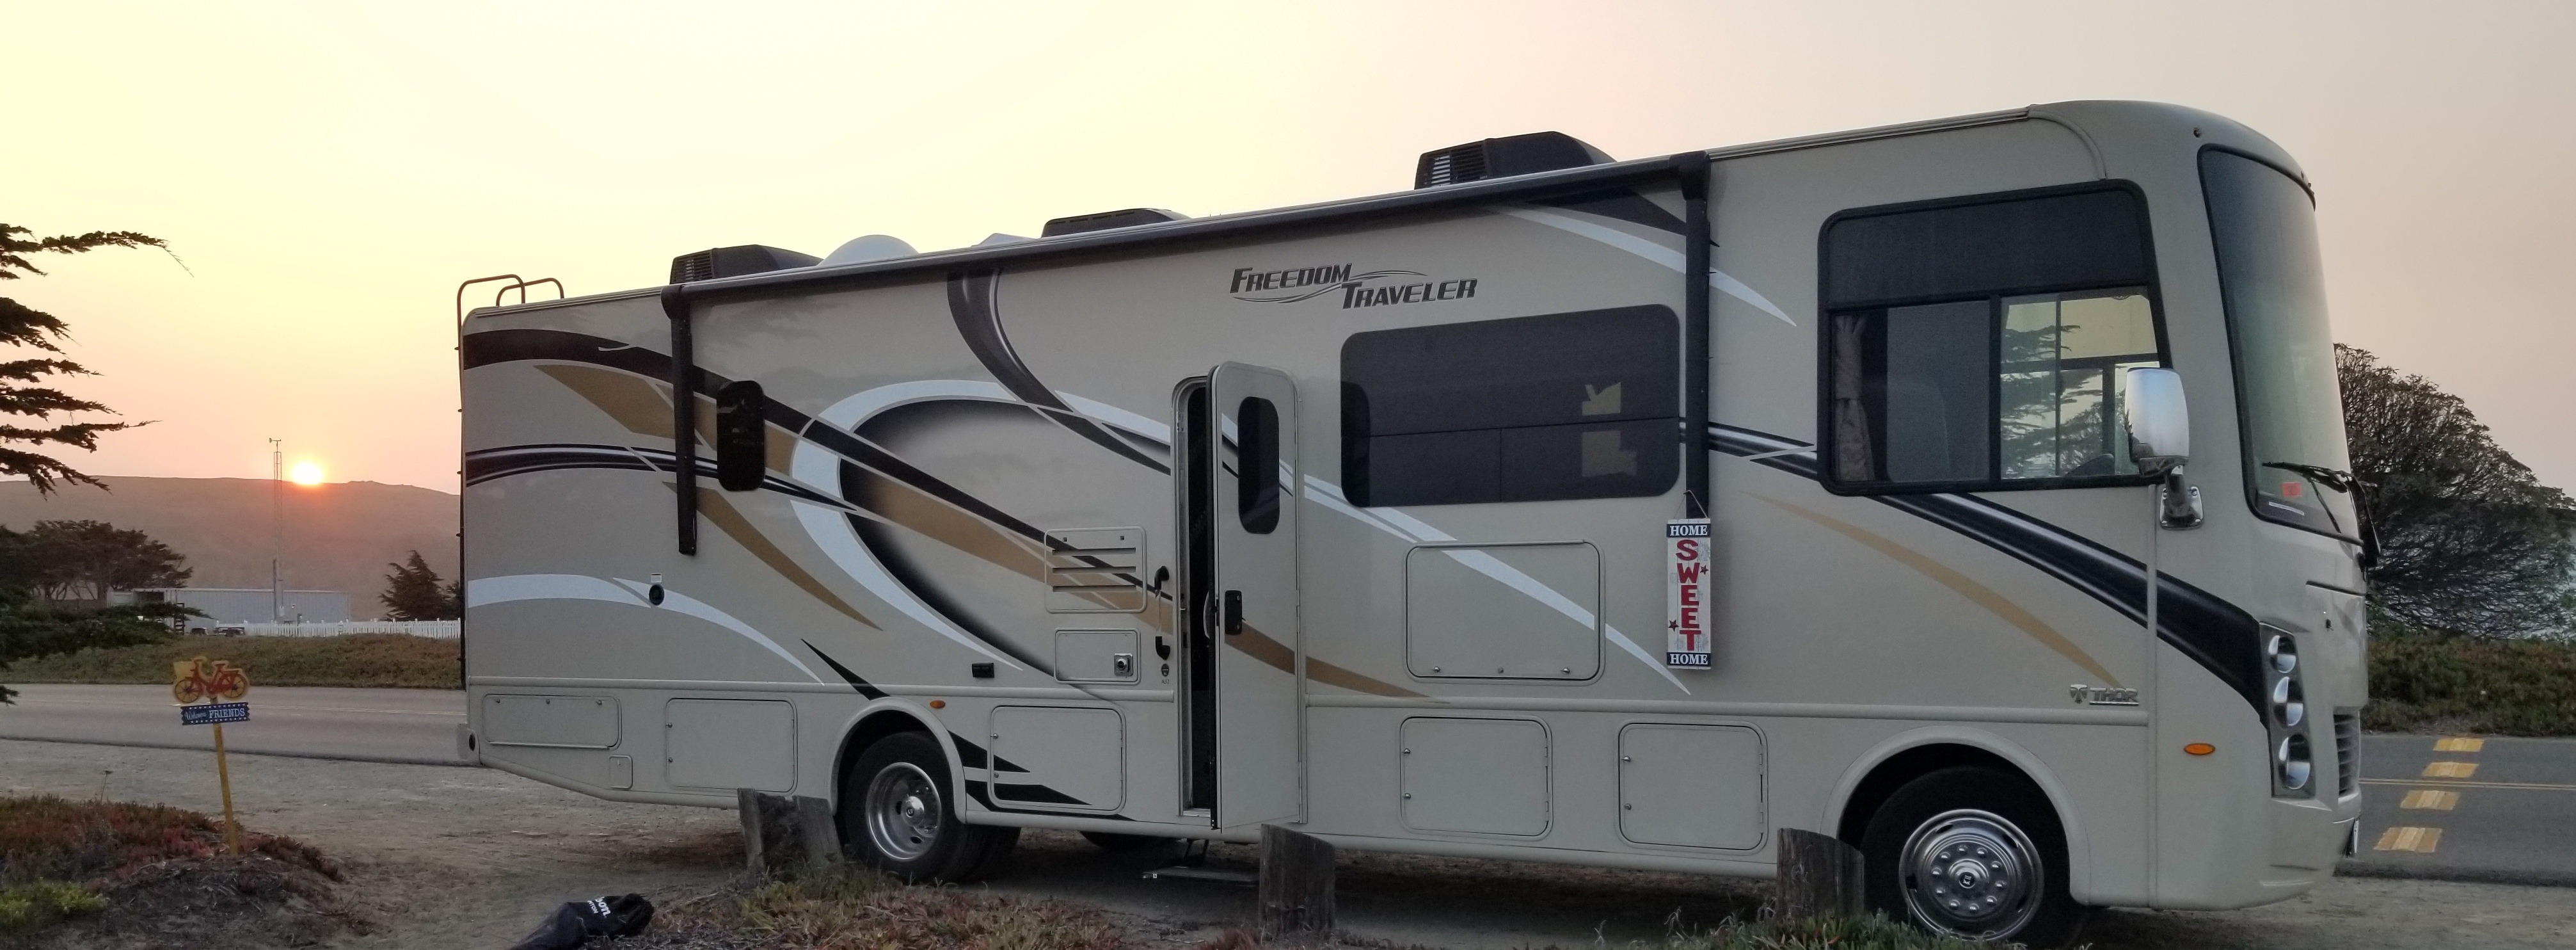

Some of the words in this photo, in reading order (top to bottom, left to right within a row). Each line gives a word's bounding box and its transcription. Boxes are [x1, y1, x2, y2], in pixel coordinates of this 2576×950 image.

[1230, 263, 1352, 293] FREEDOM
[1342, 278, 1478, 309] TRAVELER
[1669, 525, 1708, 536] HOME
[1676, 539, 1701, 651] SWEET
[1670, 654, 1708, 665] HOME
[2090, 688, 2138, 702] THOR
[209, 708, 245, 718] FRIENDS
